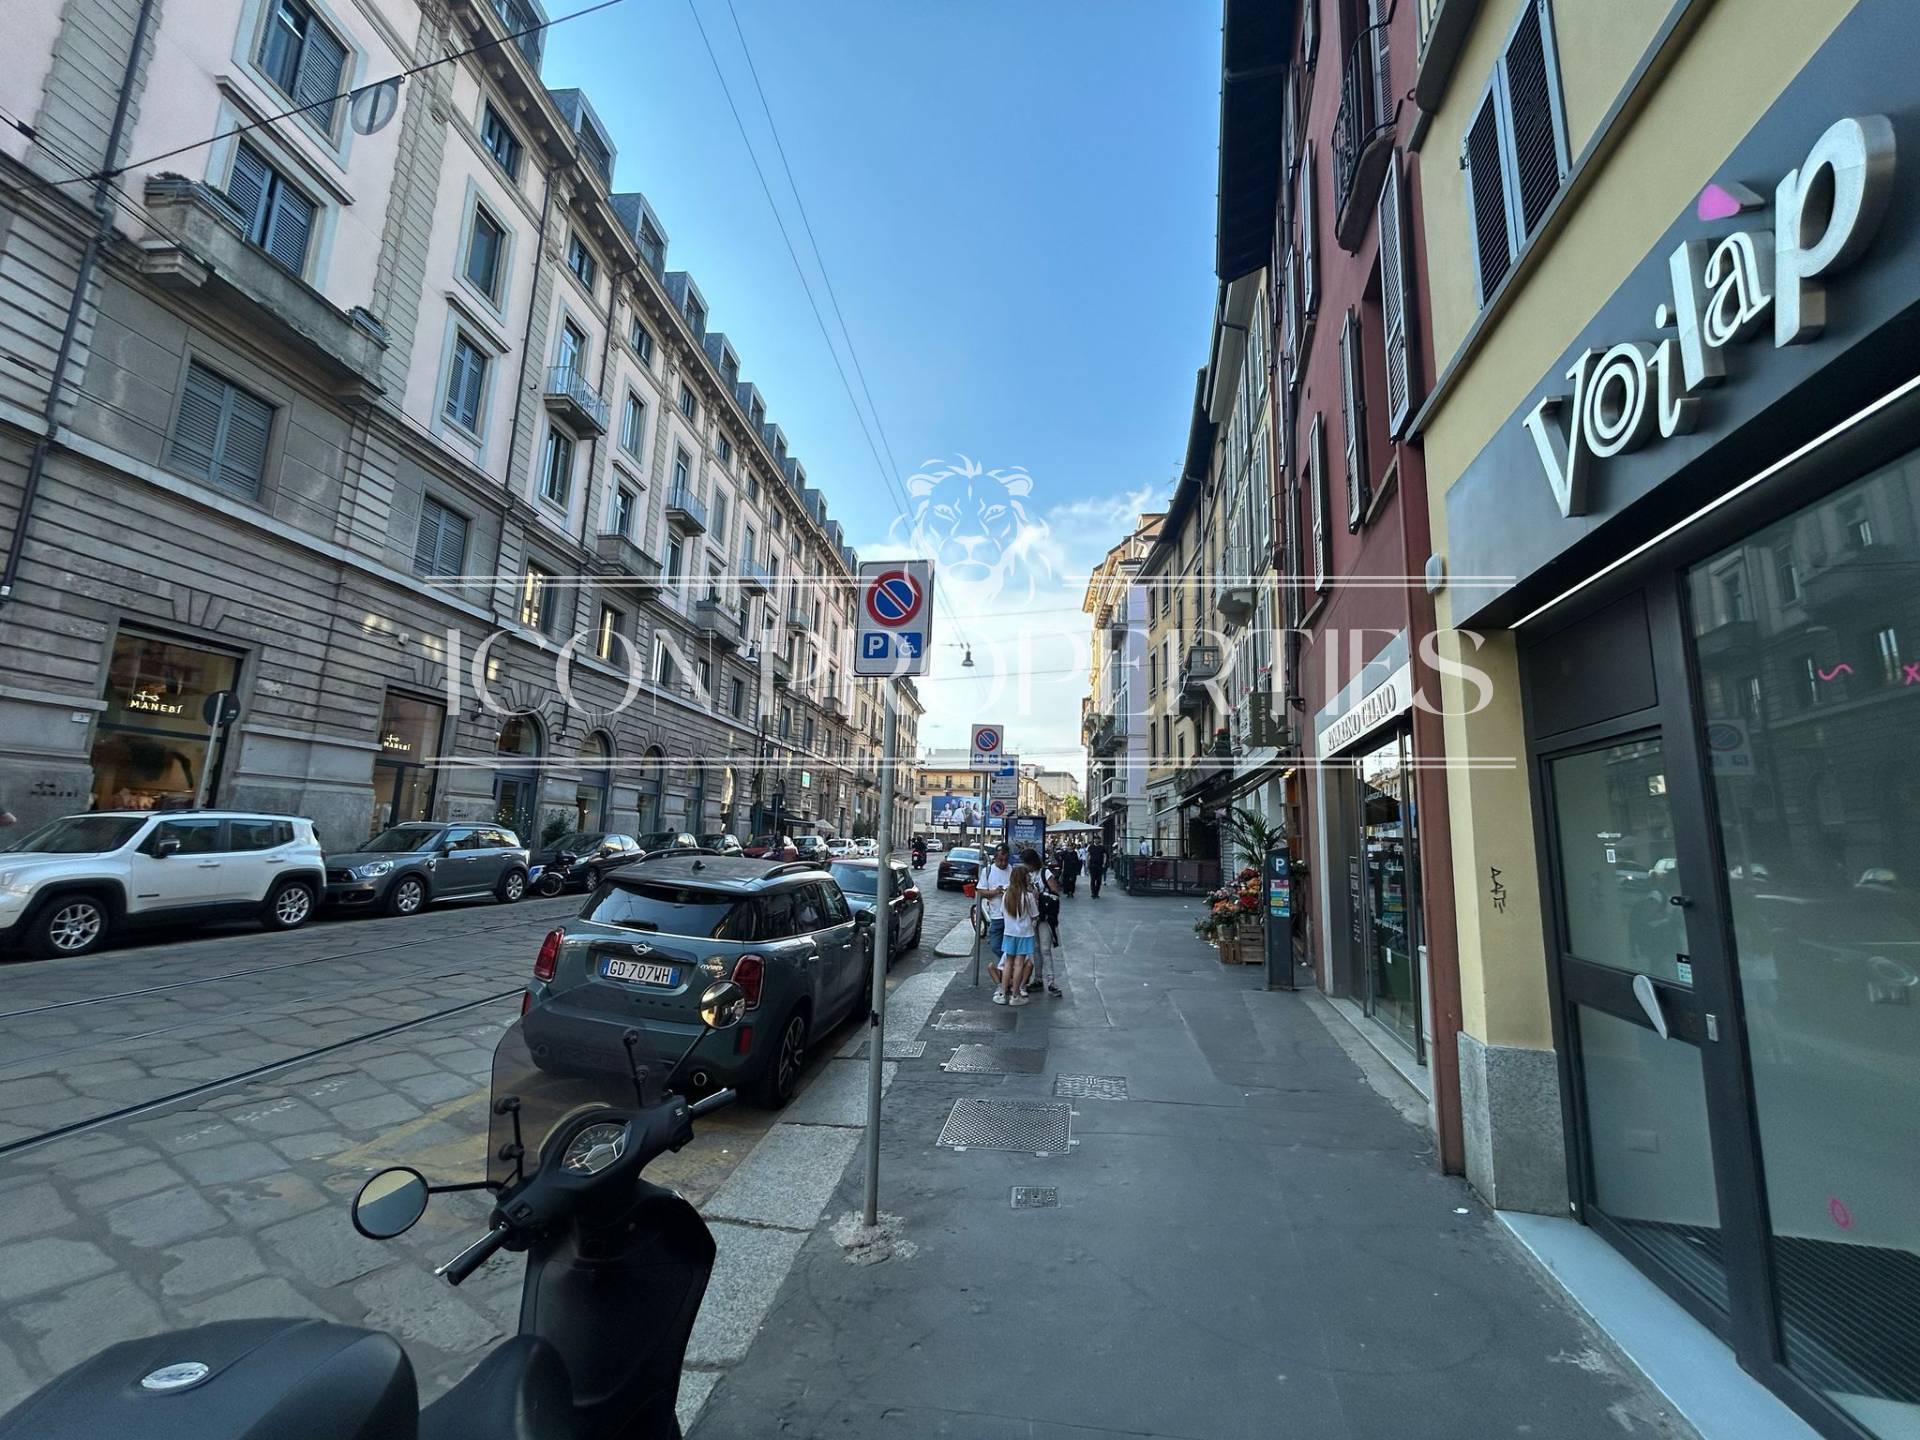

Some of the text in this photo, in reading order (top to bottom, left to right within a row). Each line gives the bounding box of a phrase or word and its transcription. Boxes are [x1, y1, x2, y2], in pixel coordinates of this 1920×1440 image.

[868, 636, 884, 656] P
[1275, 858, 1285, 871] P
[609, 960, 671, 984] GD 707WH
